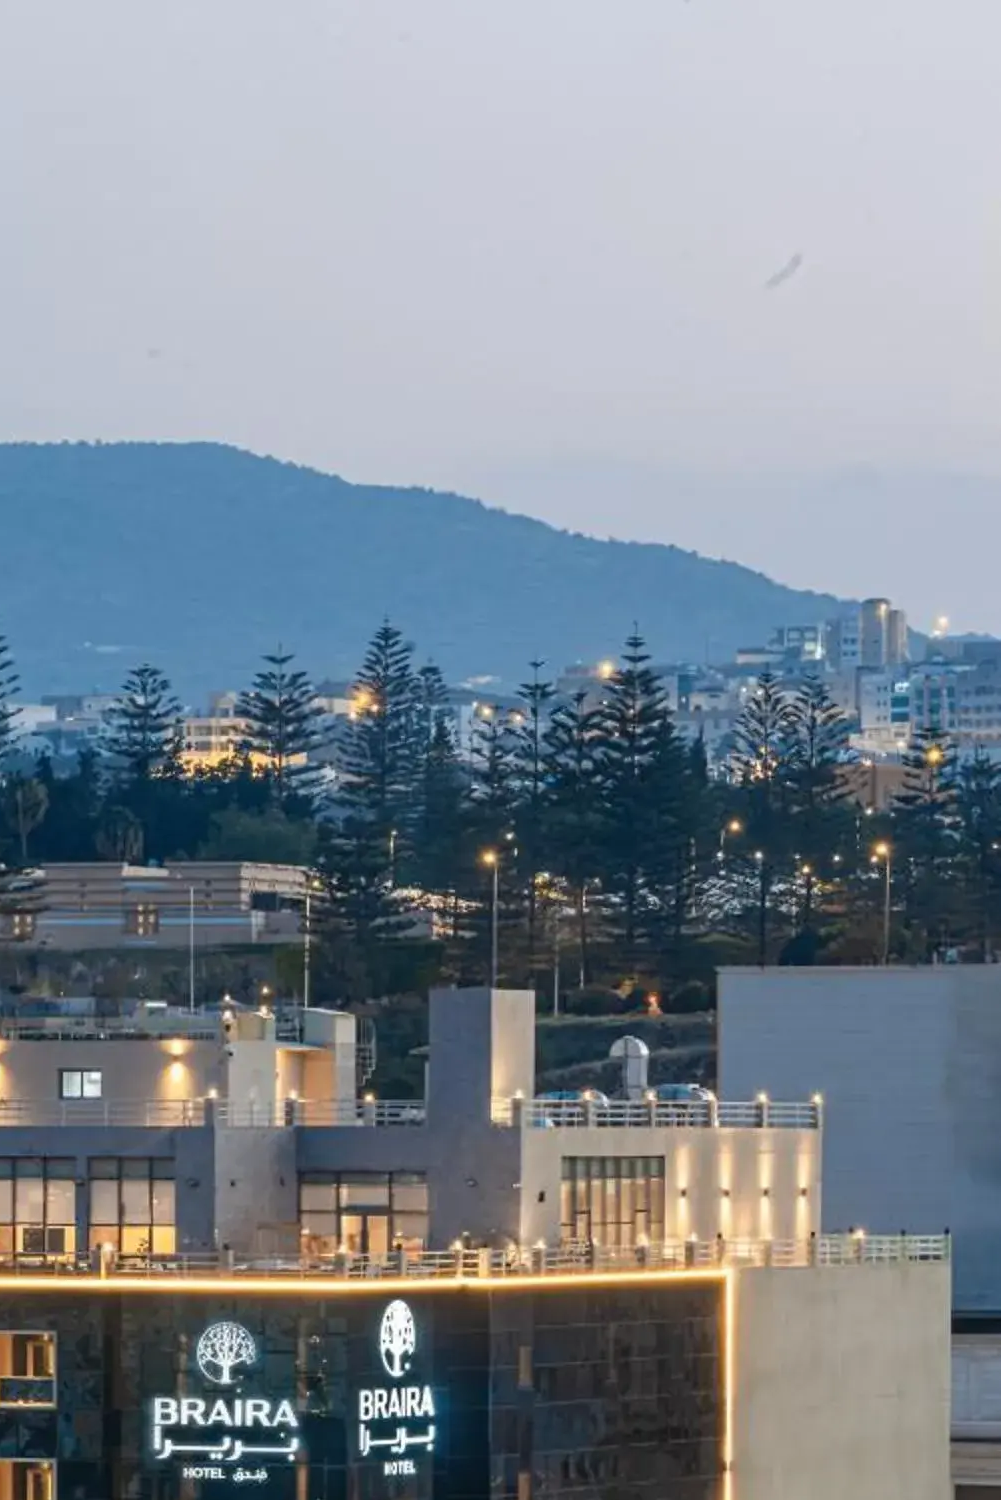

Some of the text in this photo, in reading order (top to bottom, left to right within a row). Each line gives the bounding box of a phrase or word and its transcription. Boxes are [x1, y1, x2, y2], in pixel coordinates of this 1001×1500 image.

[153, 1397, 299, 1427] BRAIRA
[358, 1385, 436, 1421] BRAIRA
[153, 1426, 299, 1461] بريرا
[183, 1467, 227, 1480] HOTEL
[384, 1459, 416, 1476] HOTEL
